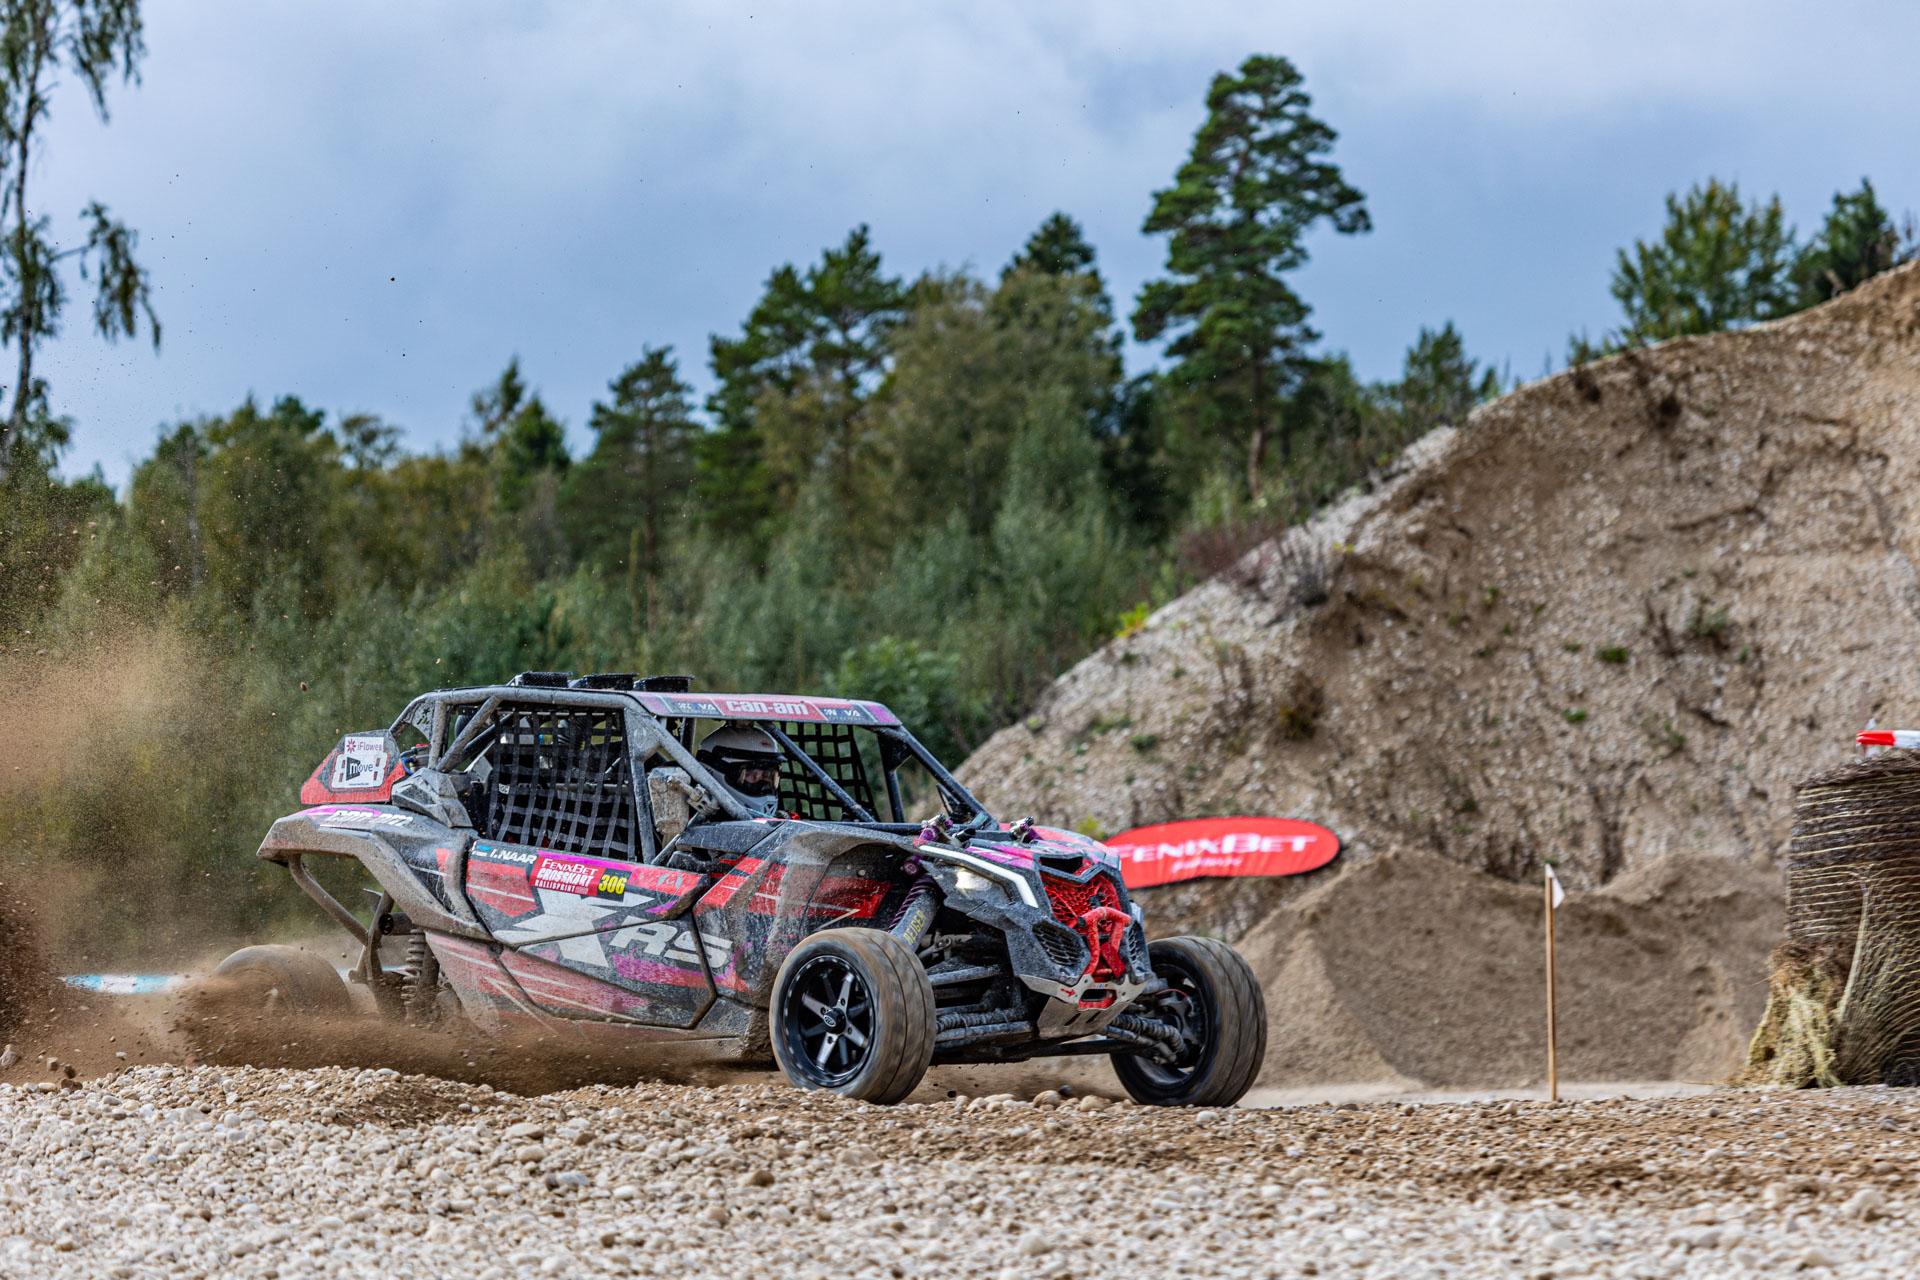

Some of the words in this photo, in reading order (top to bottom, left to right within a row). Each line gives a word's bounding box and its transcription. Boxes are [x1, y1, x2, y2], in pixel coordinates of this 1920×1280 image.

[726, 700, 809, 716] can-am
[536, 867, 595, 888] CROSSKART
[598, 874, 628, 895] 306
